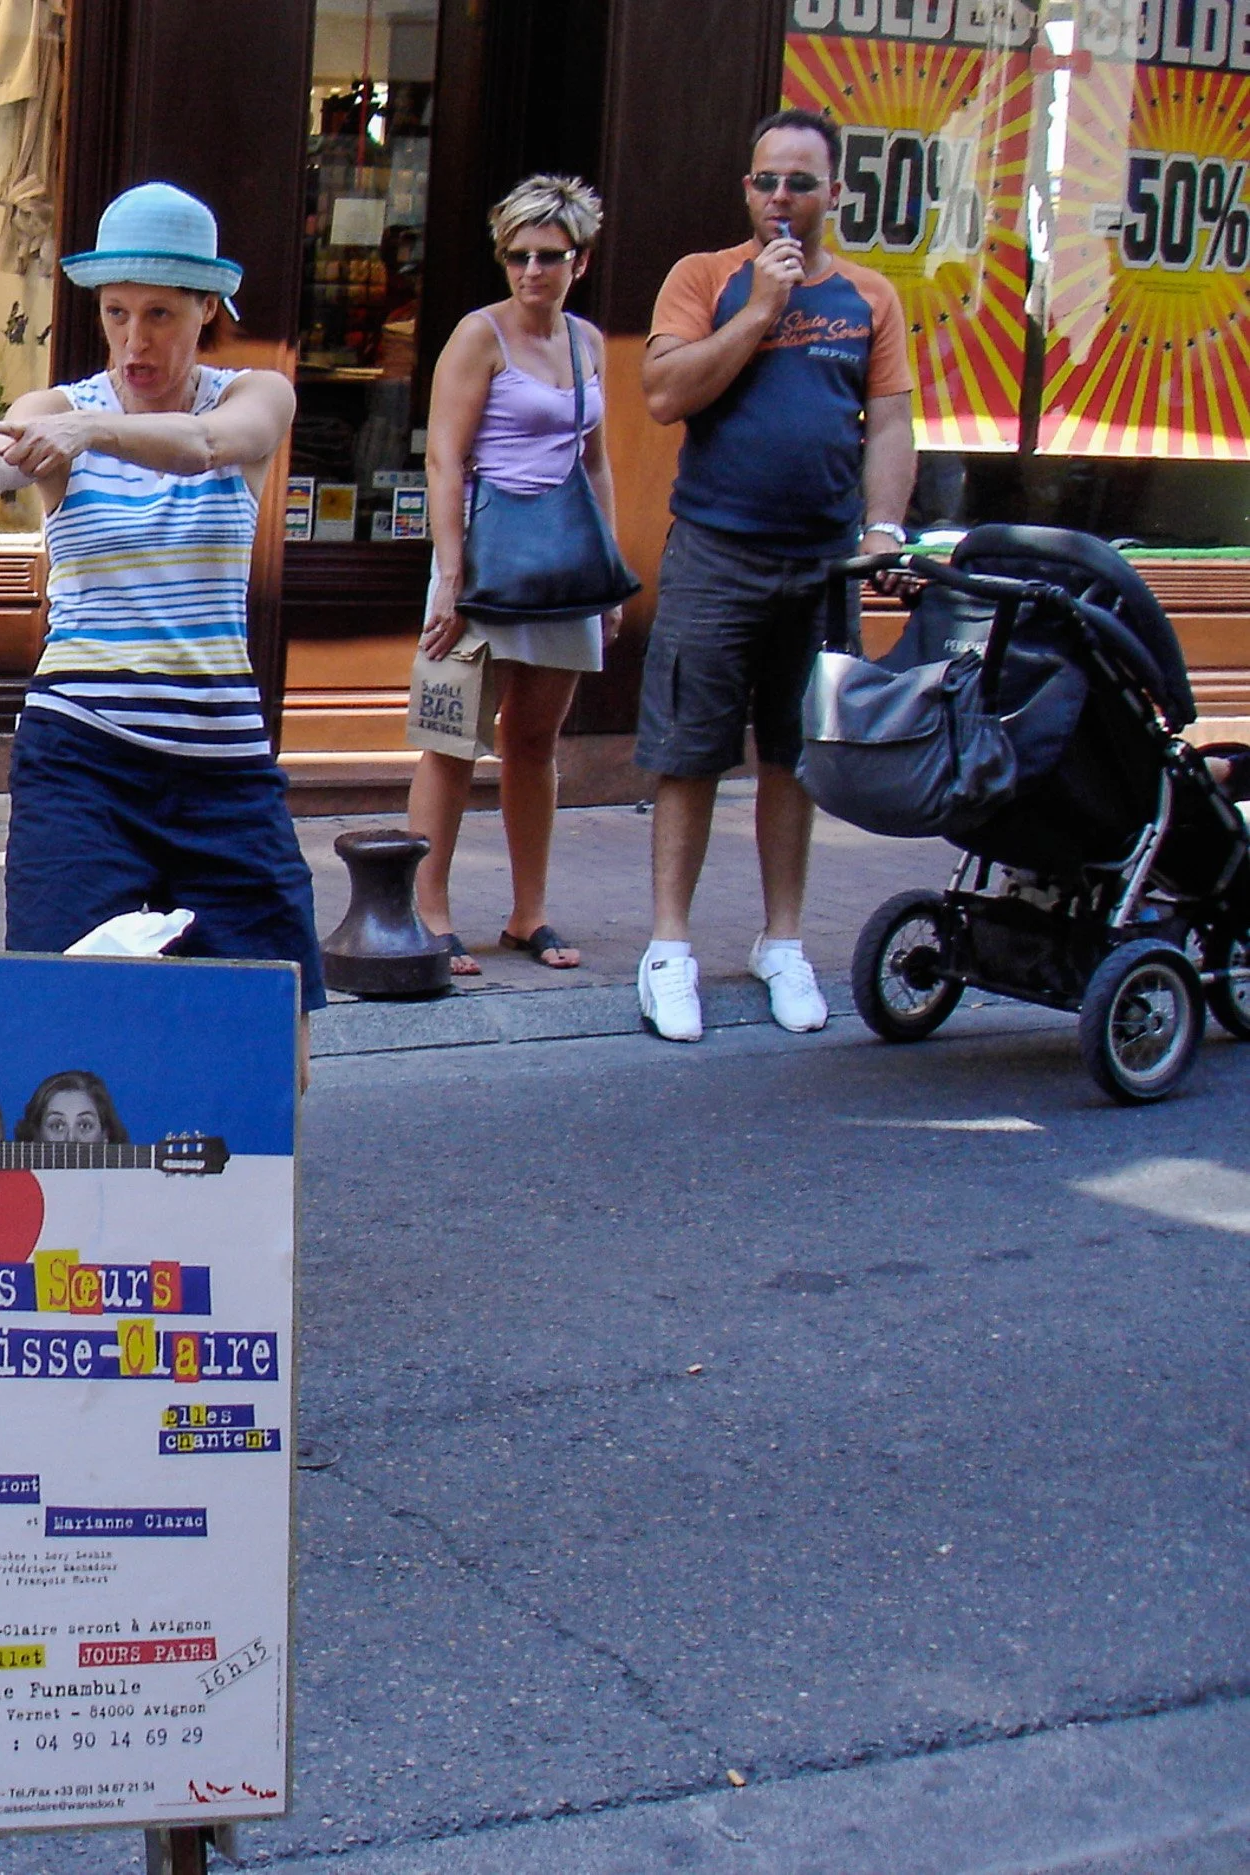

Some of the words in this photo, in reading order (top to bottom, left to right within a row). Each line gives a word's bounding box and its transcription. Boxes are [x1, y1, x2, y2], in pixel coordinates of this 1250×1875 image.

[419, 695, 463, 723] BAG
[165, 1406, 232, 1425] elles
[54, 1515, 134, 1530] Marianne
[144, 1514, 203, 1528] Clarac
[68, 1620, 121, 1635] seront
[131, 1618, 140, 1632] à
[149, 1619, 212, 1634] Avignon
[81, 1644, 142, 1665] JOURS
[153, 1642, 214, 1662] PAIRS
[31, 1679, 142, 1699] Funambule
[7, 1705, 60, 1721] Vernet
[144, 1702, 206, 1718] Avignon
[36, 1734, 58, 1751] 04
[72, 1732, 97, 1750] 90
[111, 1731, 131, 1748] 14
[146, 1728, 169, 1746] 69
[182, 1726, 204, 1744] 29
